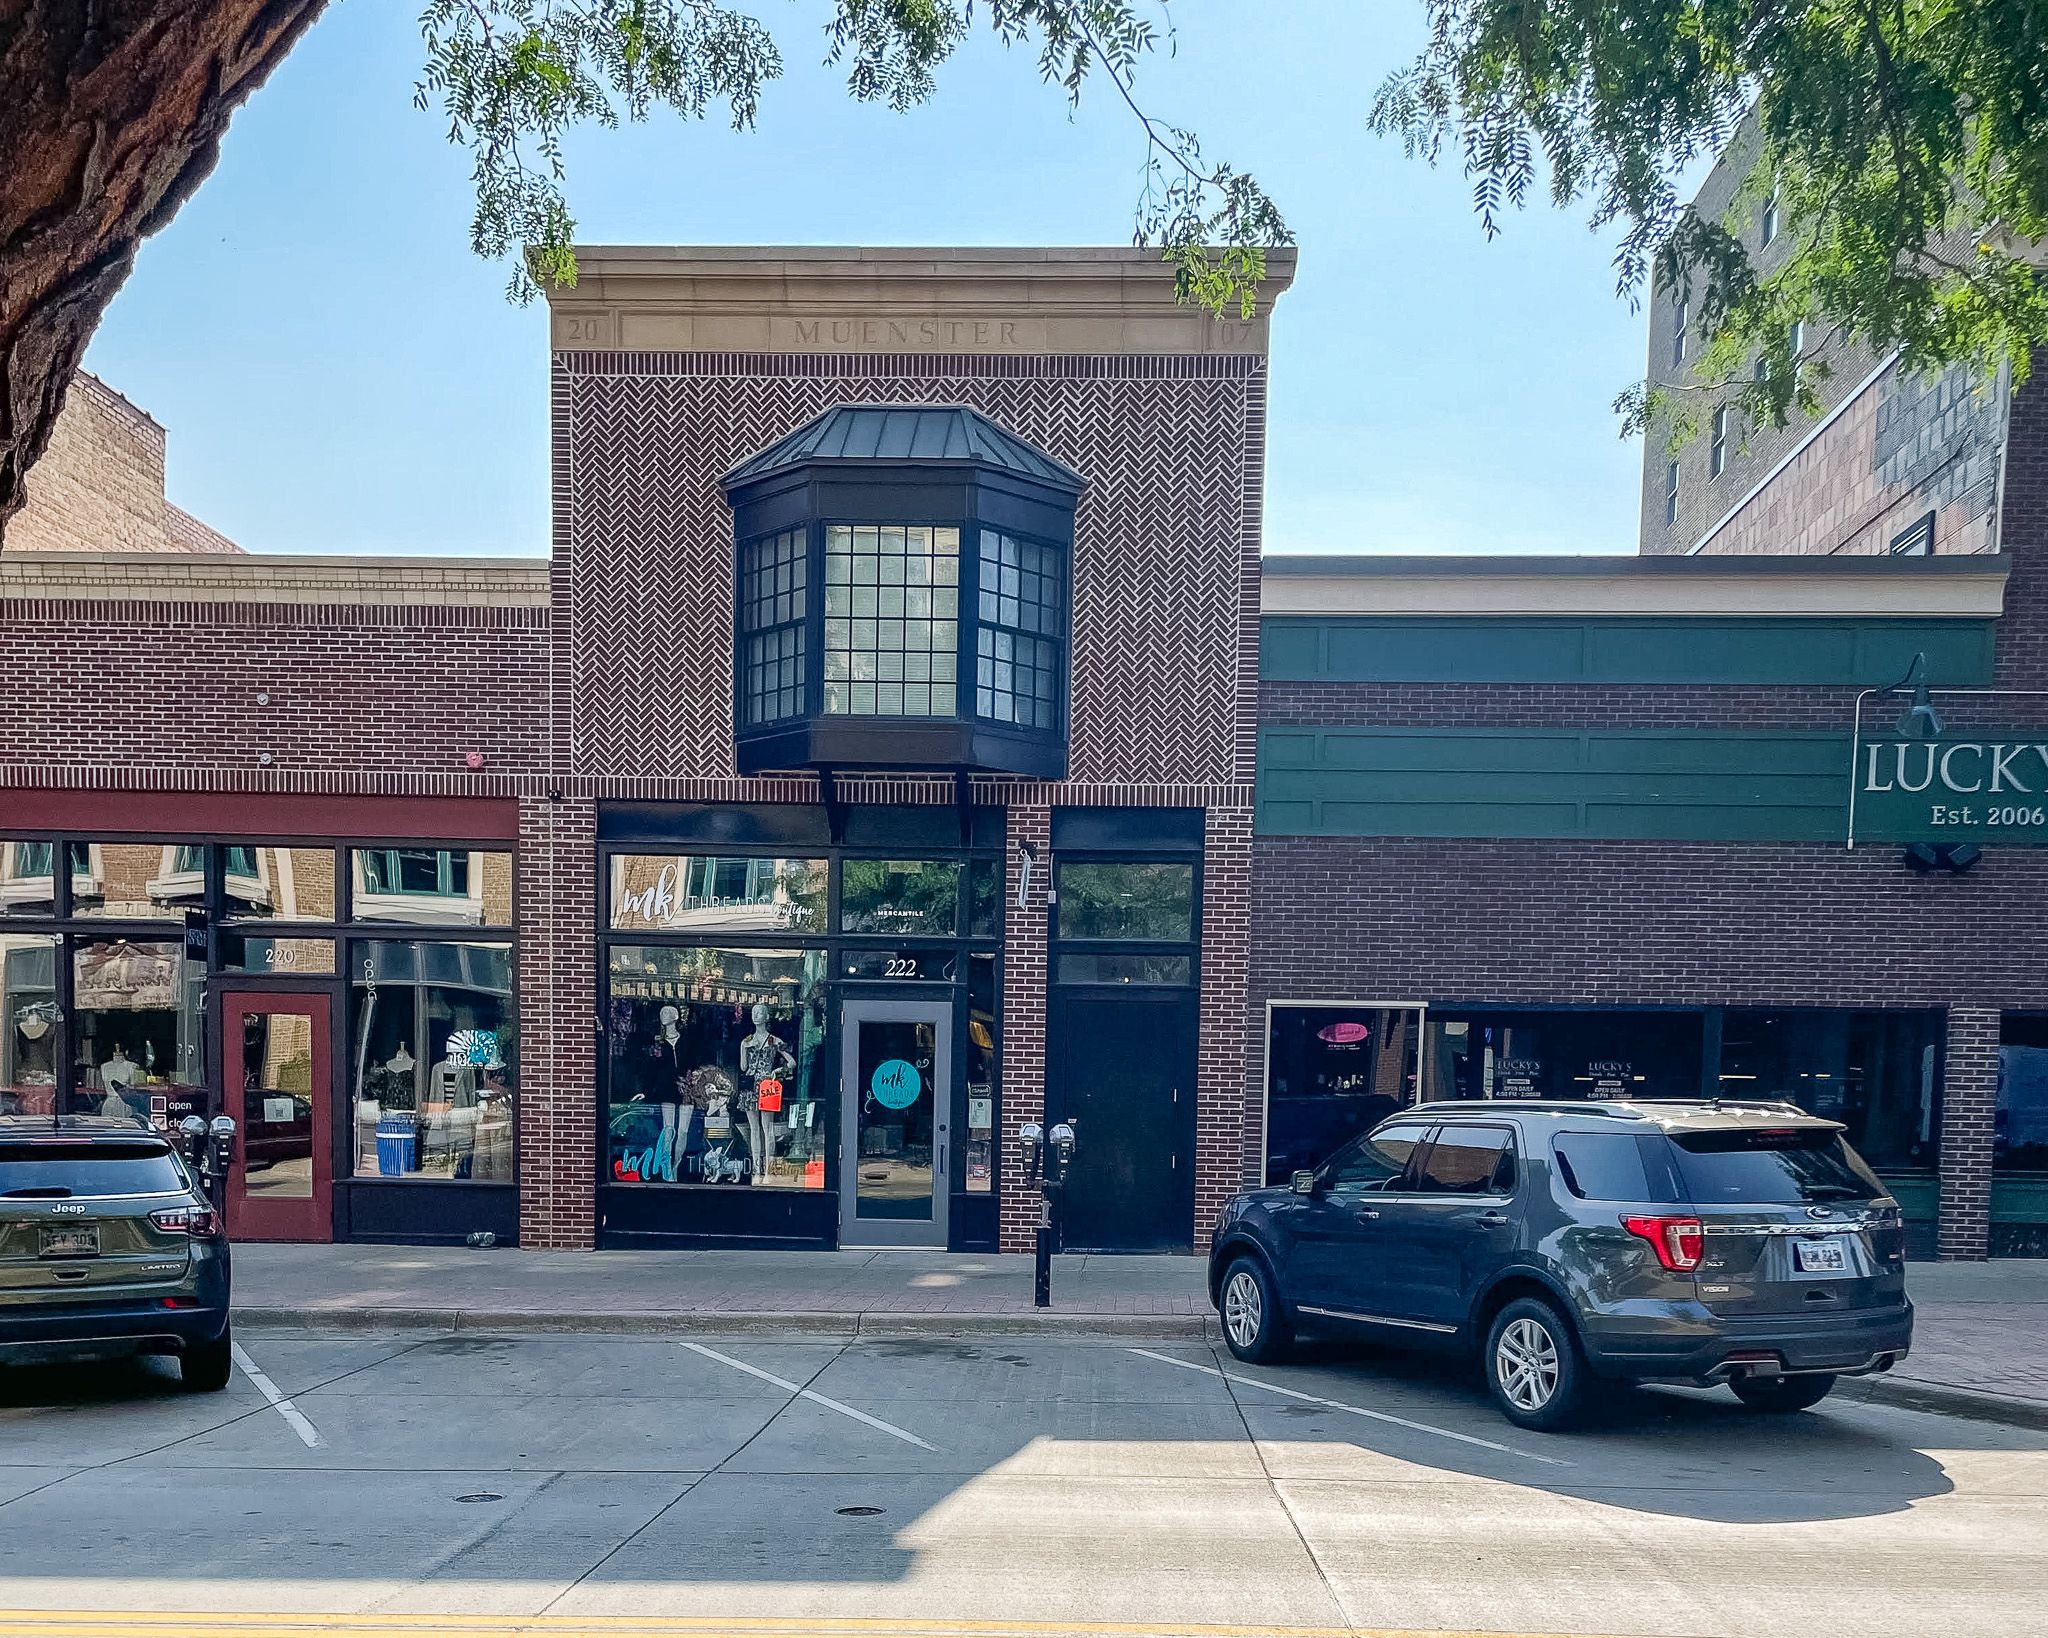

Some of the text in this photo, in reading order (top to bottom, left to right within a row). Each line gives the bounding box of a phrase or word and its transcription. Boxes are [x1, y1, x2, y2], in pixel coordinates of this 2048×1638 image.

[567, 319, 1254, 345] 20 MUENSTER 07
[1930, 805, 2045, 826] Est. 2006
[623, 864, 685, 922] mk
[688, 895, 768, 918] THREADS
[265, 948, 296, 963] 220
[884, 959, 917, 977] 222
[363, 959, 377, 1000] open
[881, 1063, 909, 1089] mk
[761, 1086, 780, 1098] SALE
[168, 1102, 192, 1111] open
[51, 1203, 86, 1215] Jeep
